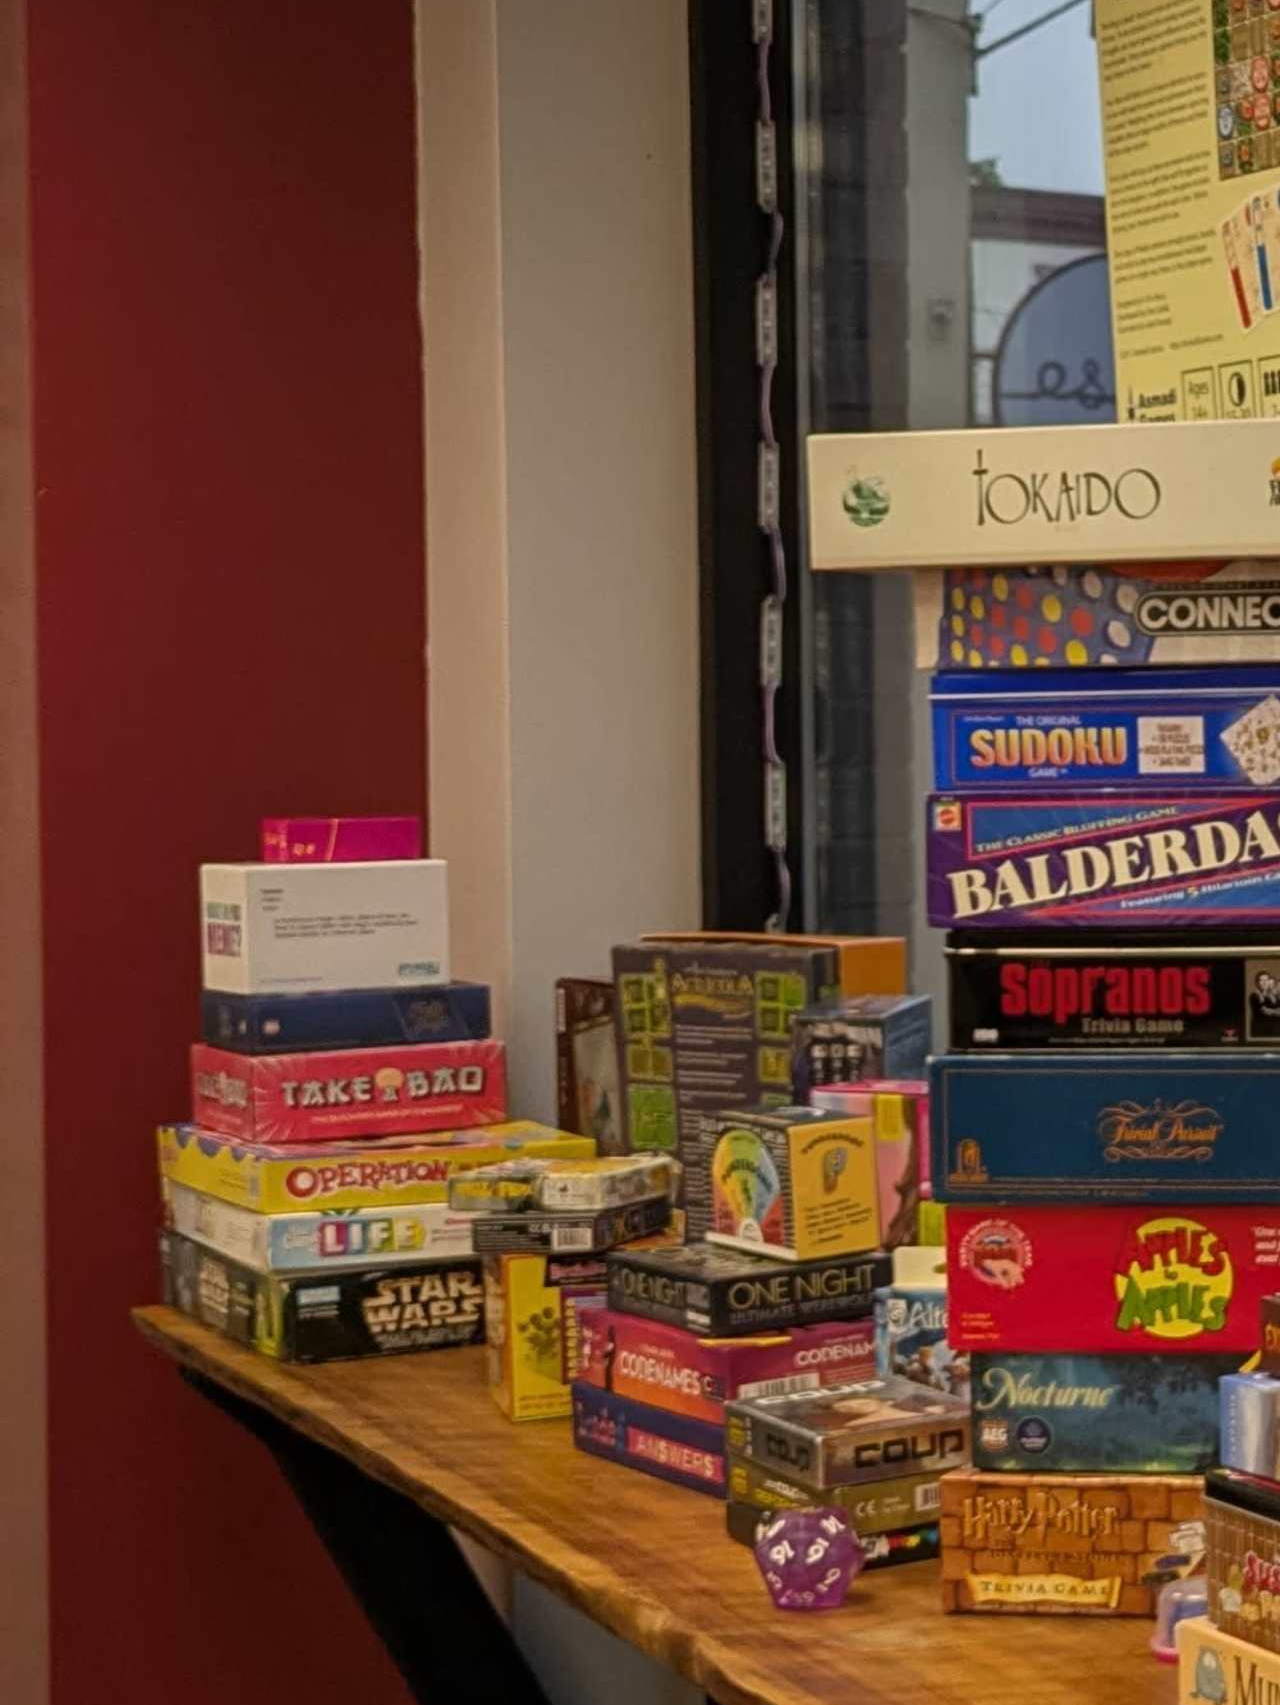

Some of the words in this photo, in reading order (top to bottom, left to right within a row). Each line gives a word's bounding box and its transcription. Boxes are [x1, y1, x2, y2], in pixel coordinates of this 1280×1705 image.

[969, 726, 1128, 768] SUDOKU
[1135, 805, 1179, 823] GAME
[1001, 962, 1211, 1026] Sopranos
[1082, 1017, 1131, 1034] Trivia
[1134, 1017, 1184, 1035] Game
[281, 1076, 372, 1107] TAKE
[407, 1066, 484, 1097] BAO
[285, 1159, 448, 1198] OPERATION
[322, 1219, 416, 1257] LIFE
[1118, 1225, 1229, 1278] APPLES
[363, 1270, 485, 1308] STAR
[728, 1276, 790, 1311] ONE
[796, 1263, 877, 1299] NIGHT
[1113, 1276, 1227, 1333] APPLES
[363, 1296, 484, 1334] WARS
[730, 1304, 795, 1325] ULTIMATE
[618, 1348, 701, 1396] CODENAMES
[976, 1367, 1115, 1410] Nocturne
[637, 1433, 717, 1477] ANSWERS
[853, 1427, 965, 1469] COUP
[962, 1493, 1034, 1541] Harry
[1037, 1488, 1118, 1541] Potter
[979, 1579, 1049, 1595] TRIVIA
[1053, 1579, 1110, 1596] GAME
